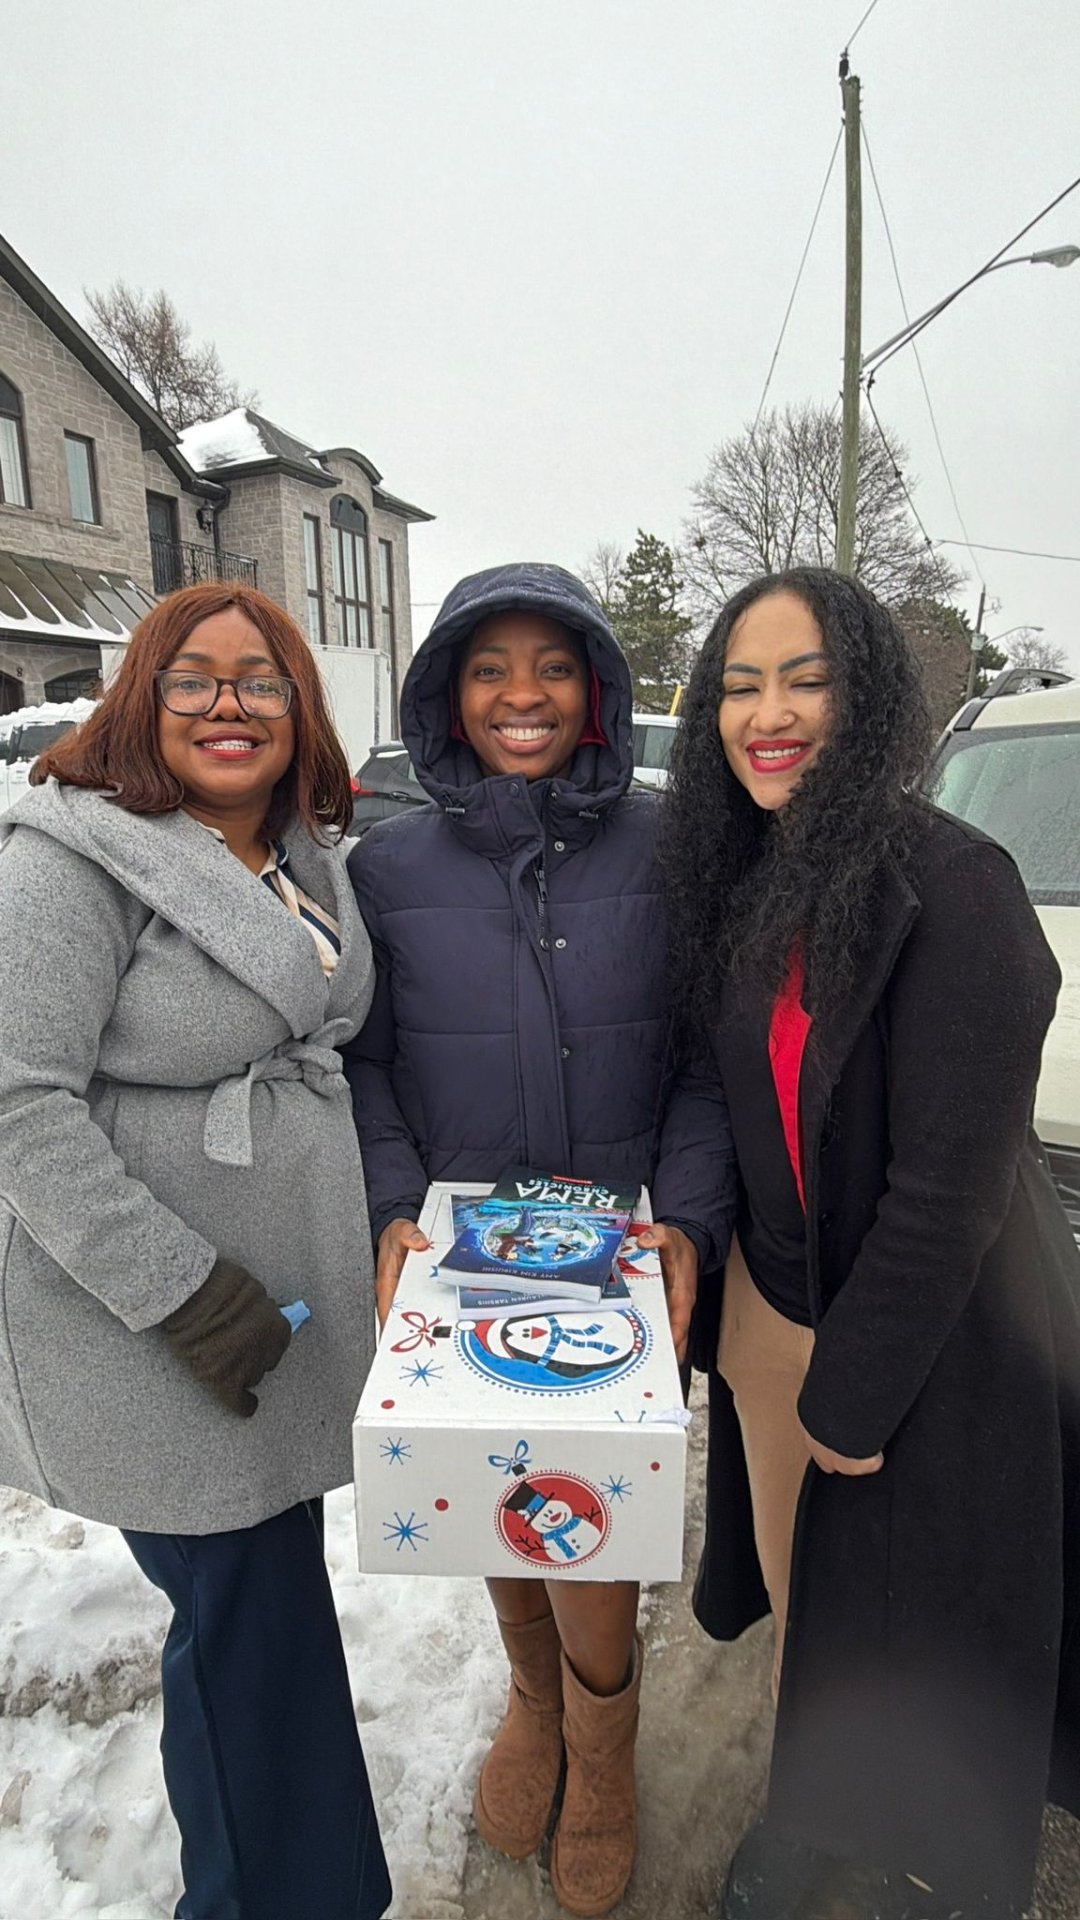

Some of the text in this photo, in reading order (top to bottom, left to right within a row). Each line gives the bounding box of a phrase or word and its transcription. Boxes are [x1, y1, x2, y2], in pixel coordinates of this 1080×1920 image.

[16, 666, 23, 677] 8
[515, 1181, 619, 1209] REMA
[528, 1179, 609, 1195] CHRONICLES
